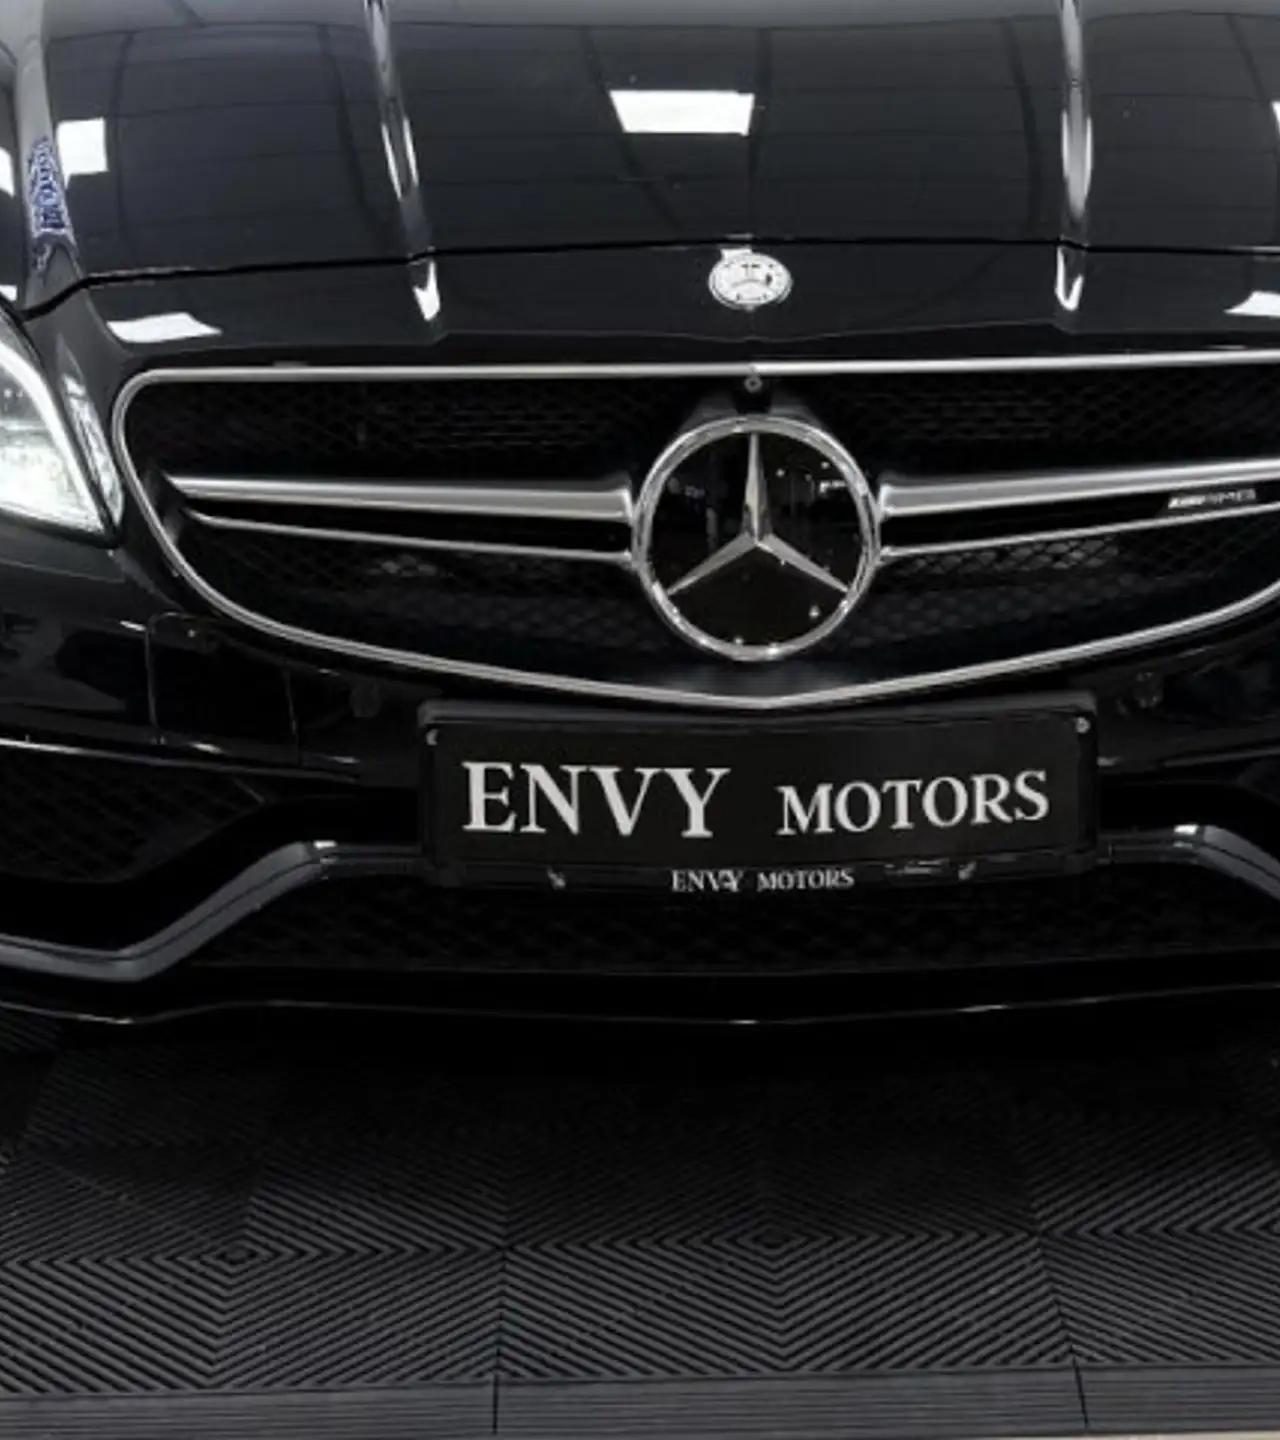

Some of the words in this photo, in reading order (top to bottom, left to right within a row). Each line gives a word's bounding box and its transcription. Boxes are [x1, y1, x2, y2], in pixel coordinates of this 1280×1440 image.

[461, 760, 731, 839] ENVY
[776, 769, 1050, 836] MOTORS
[671, 868, 745, 894] ENVY
[756, 866, 856, 893] MOTORS
